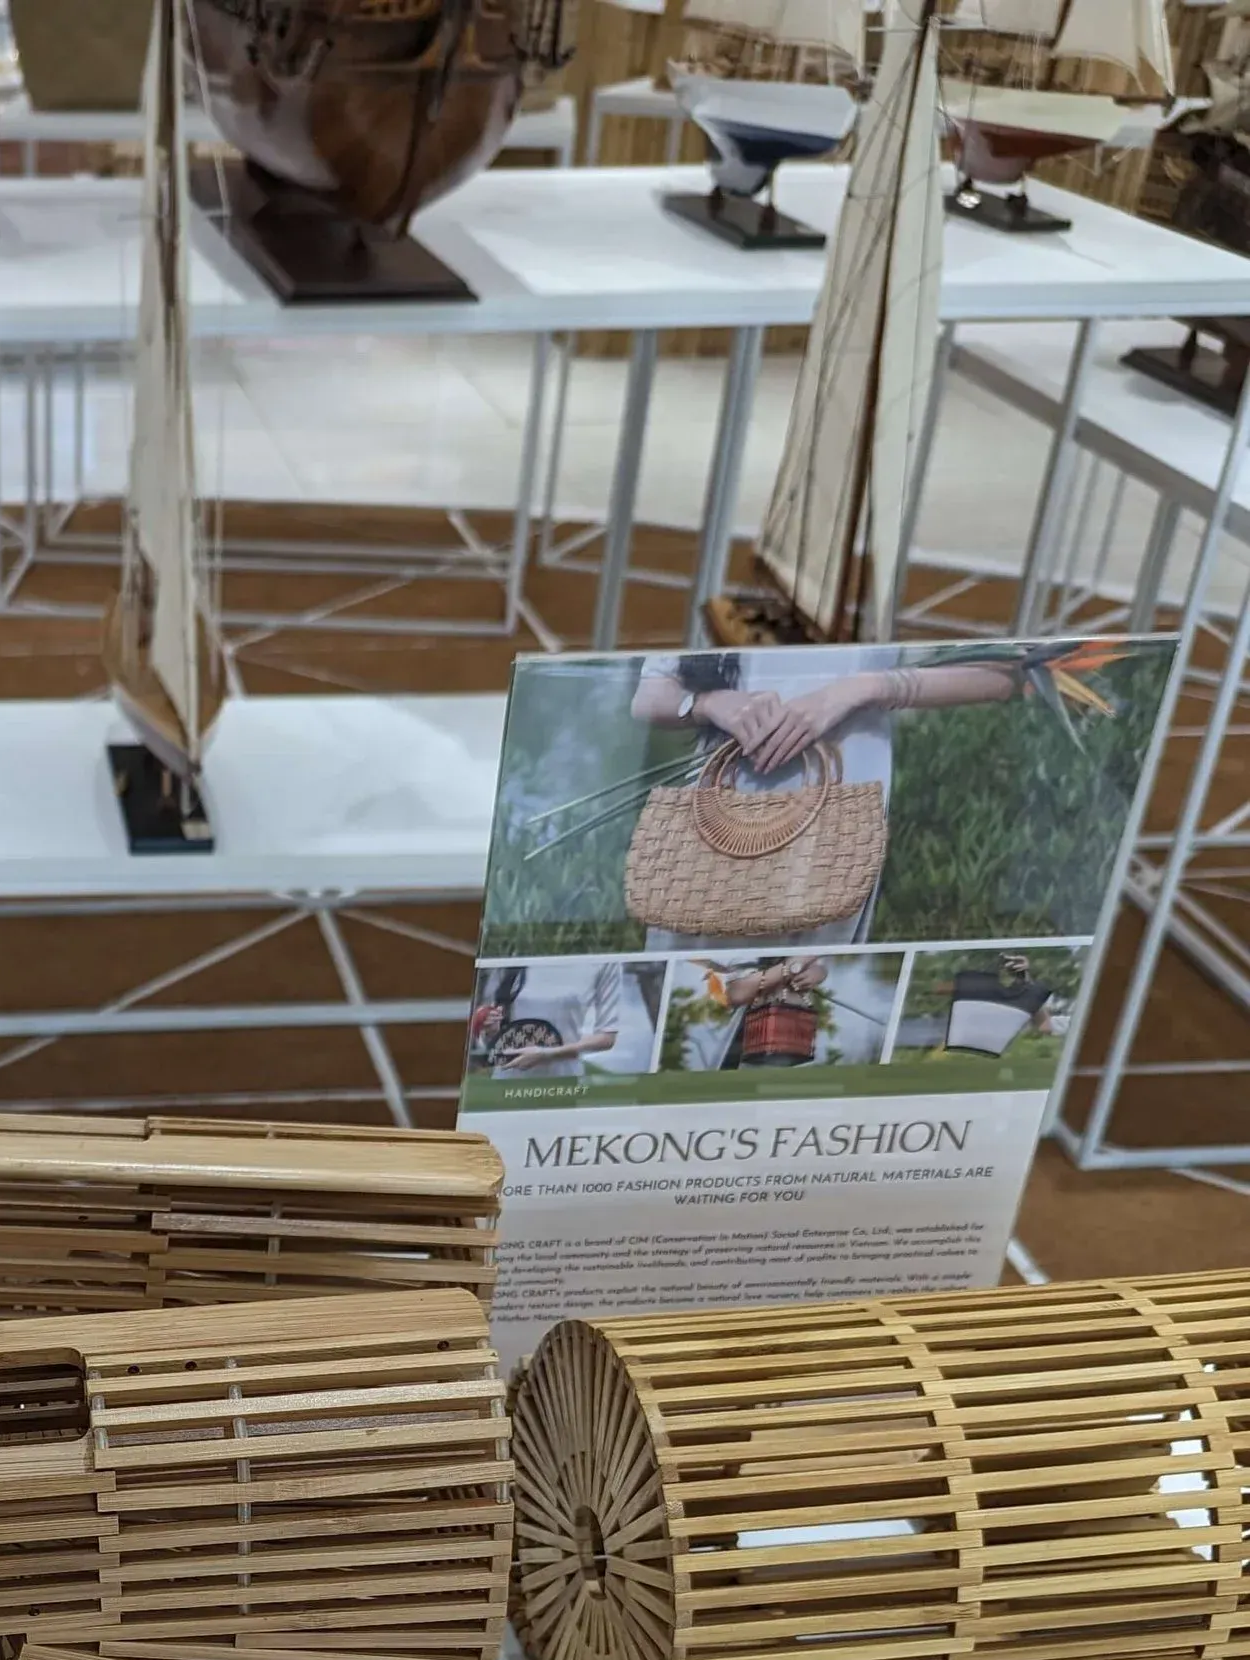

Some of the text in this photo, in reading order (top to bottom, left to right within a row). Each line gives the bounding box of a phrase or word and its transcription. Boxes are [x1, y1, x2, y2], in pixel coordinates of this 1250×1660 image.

[503, 1086, 589, 1098] HANDICRAFT
[523, 1119, 973, 1168] MEKONG'S FASHION
[501, 1166, 994, 1197] ORE THAN 1000 FASHION PRODUCTS FROM NATURAL MATERIALS ARE
[674, 1189, 806, 1205] WAITING FOR YOU
[499, 1240, 525, 1250] ONG
[528, 1238, 562, 1248] CRAFT
[584, 1236, 613, 1246] brand
[614, 1235, 626, 1245] of
